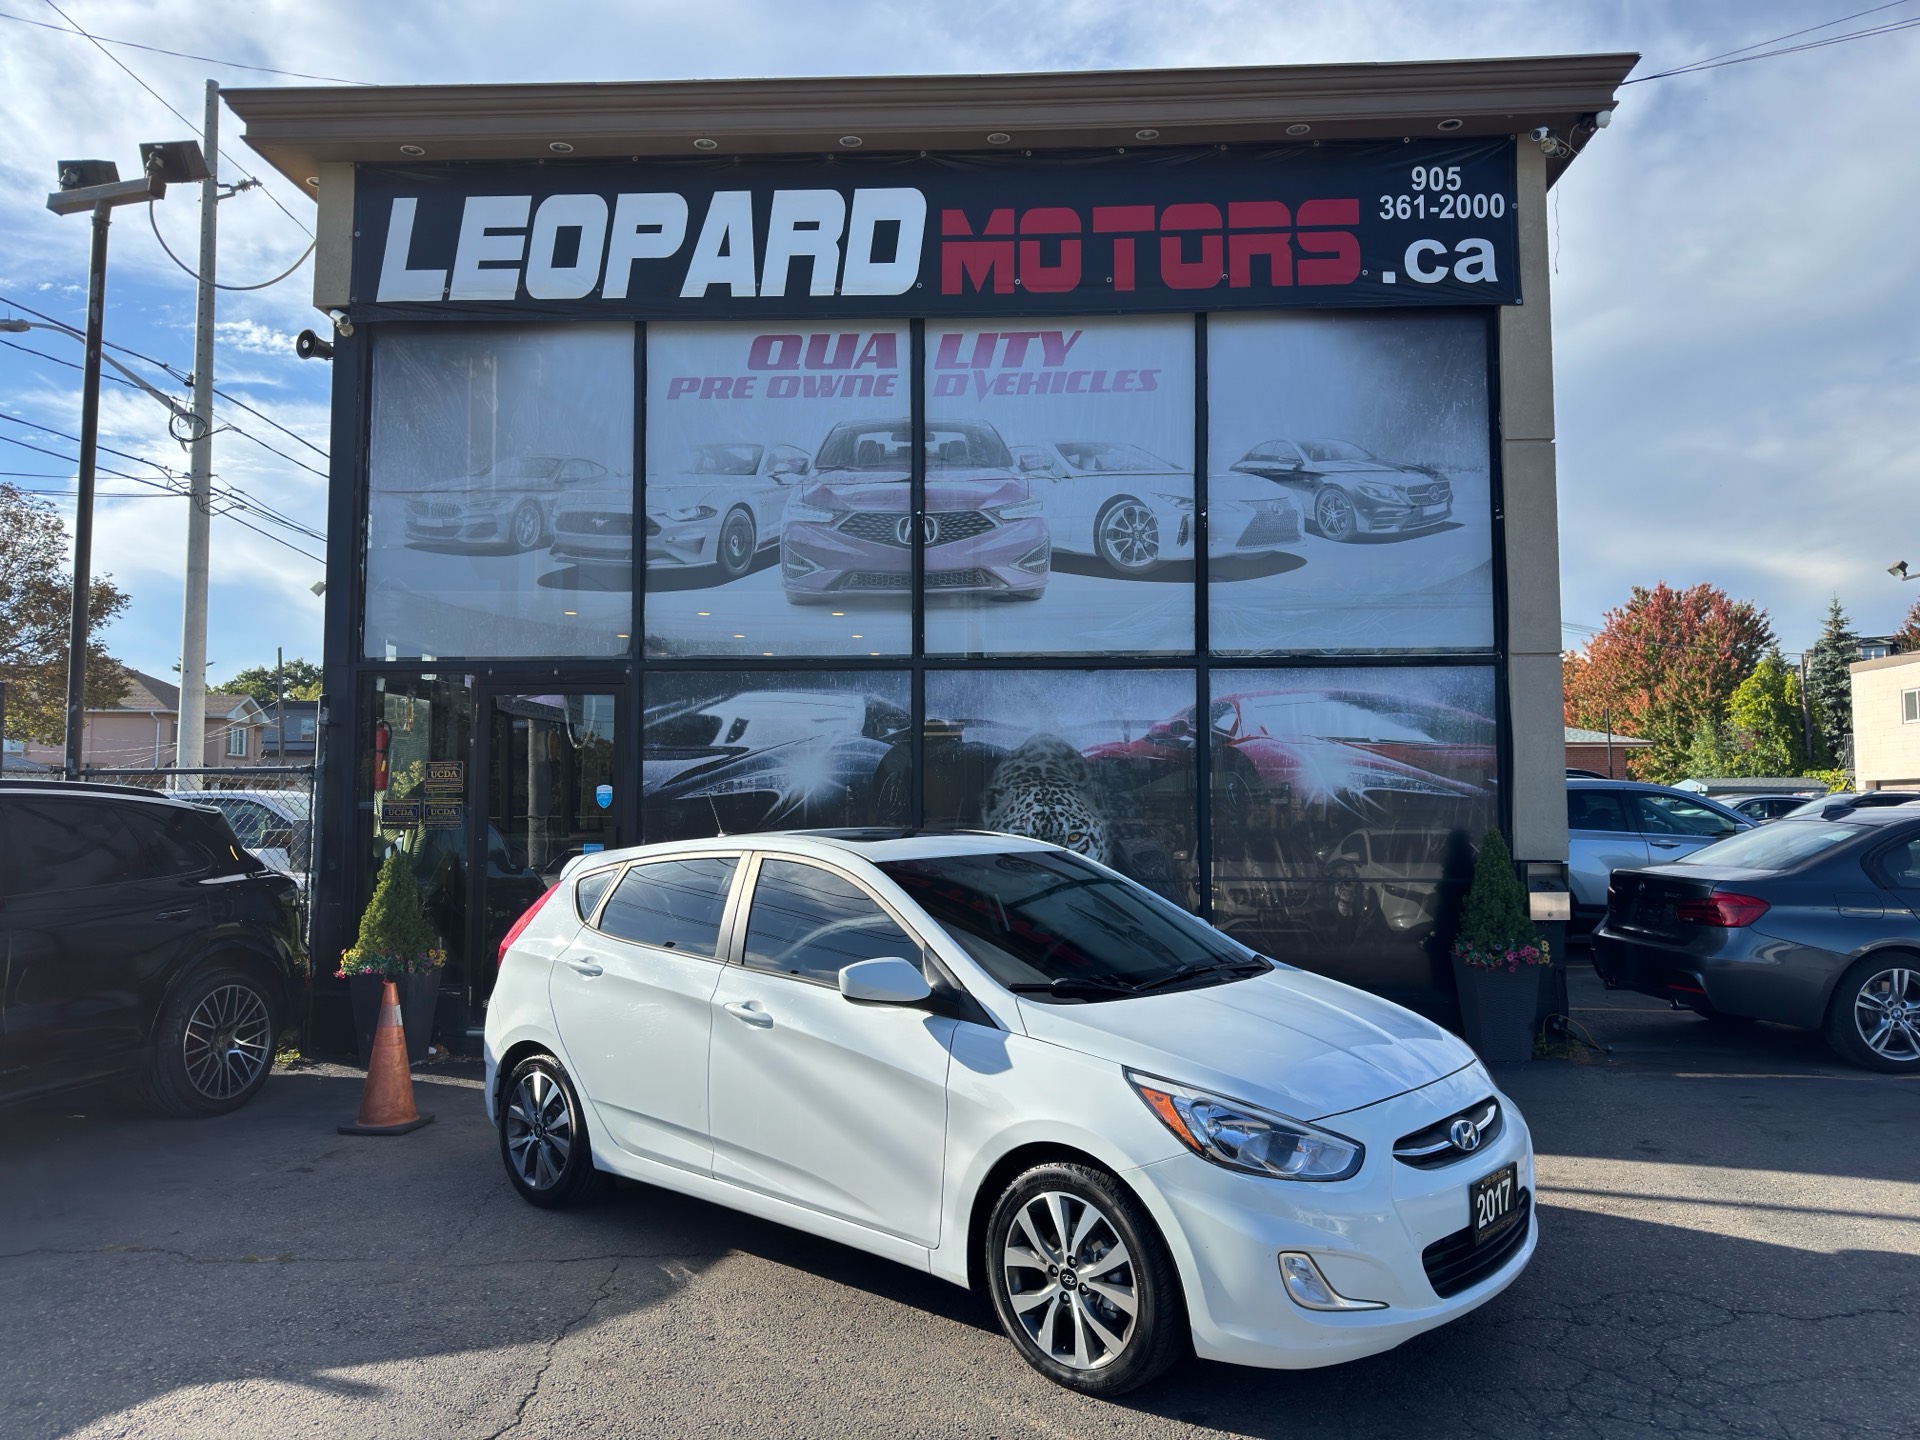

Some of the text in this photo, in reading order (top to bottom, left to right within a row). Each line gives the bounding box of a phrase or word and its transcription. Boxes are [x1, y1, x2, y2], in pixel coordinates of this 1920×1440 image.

[1411, 166, 1461, 191] 905
[1379, 193, 1505, 219] 361-2000
[376, 187, 1361, 302] LEOPARD MOTORS
[1382, 237, 1499, 284] .ca
[667, 376, 757, 400] PRE
[430, 770, 458, 778] UCDA
[430, 808, 456, 816] UCDA
[1477, 1177, 1511, 1230] 2017
